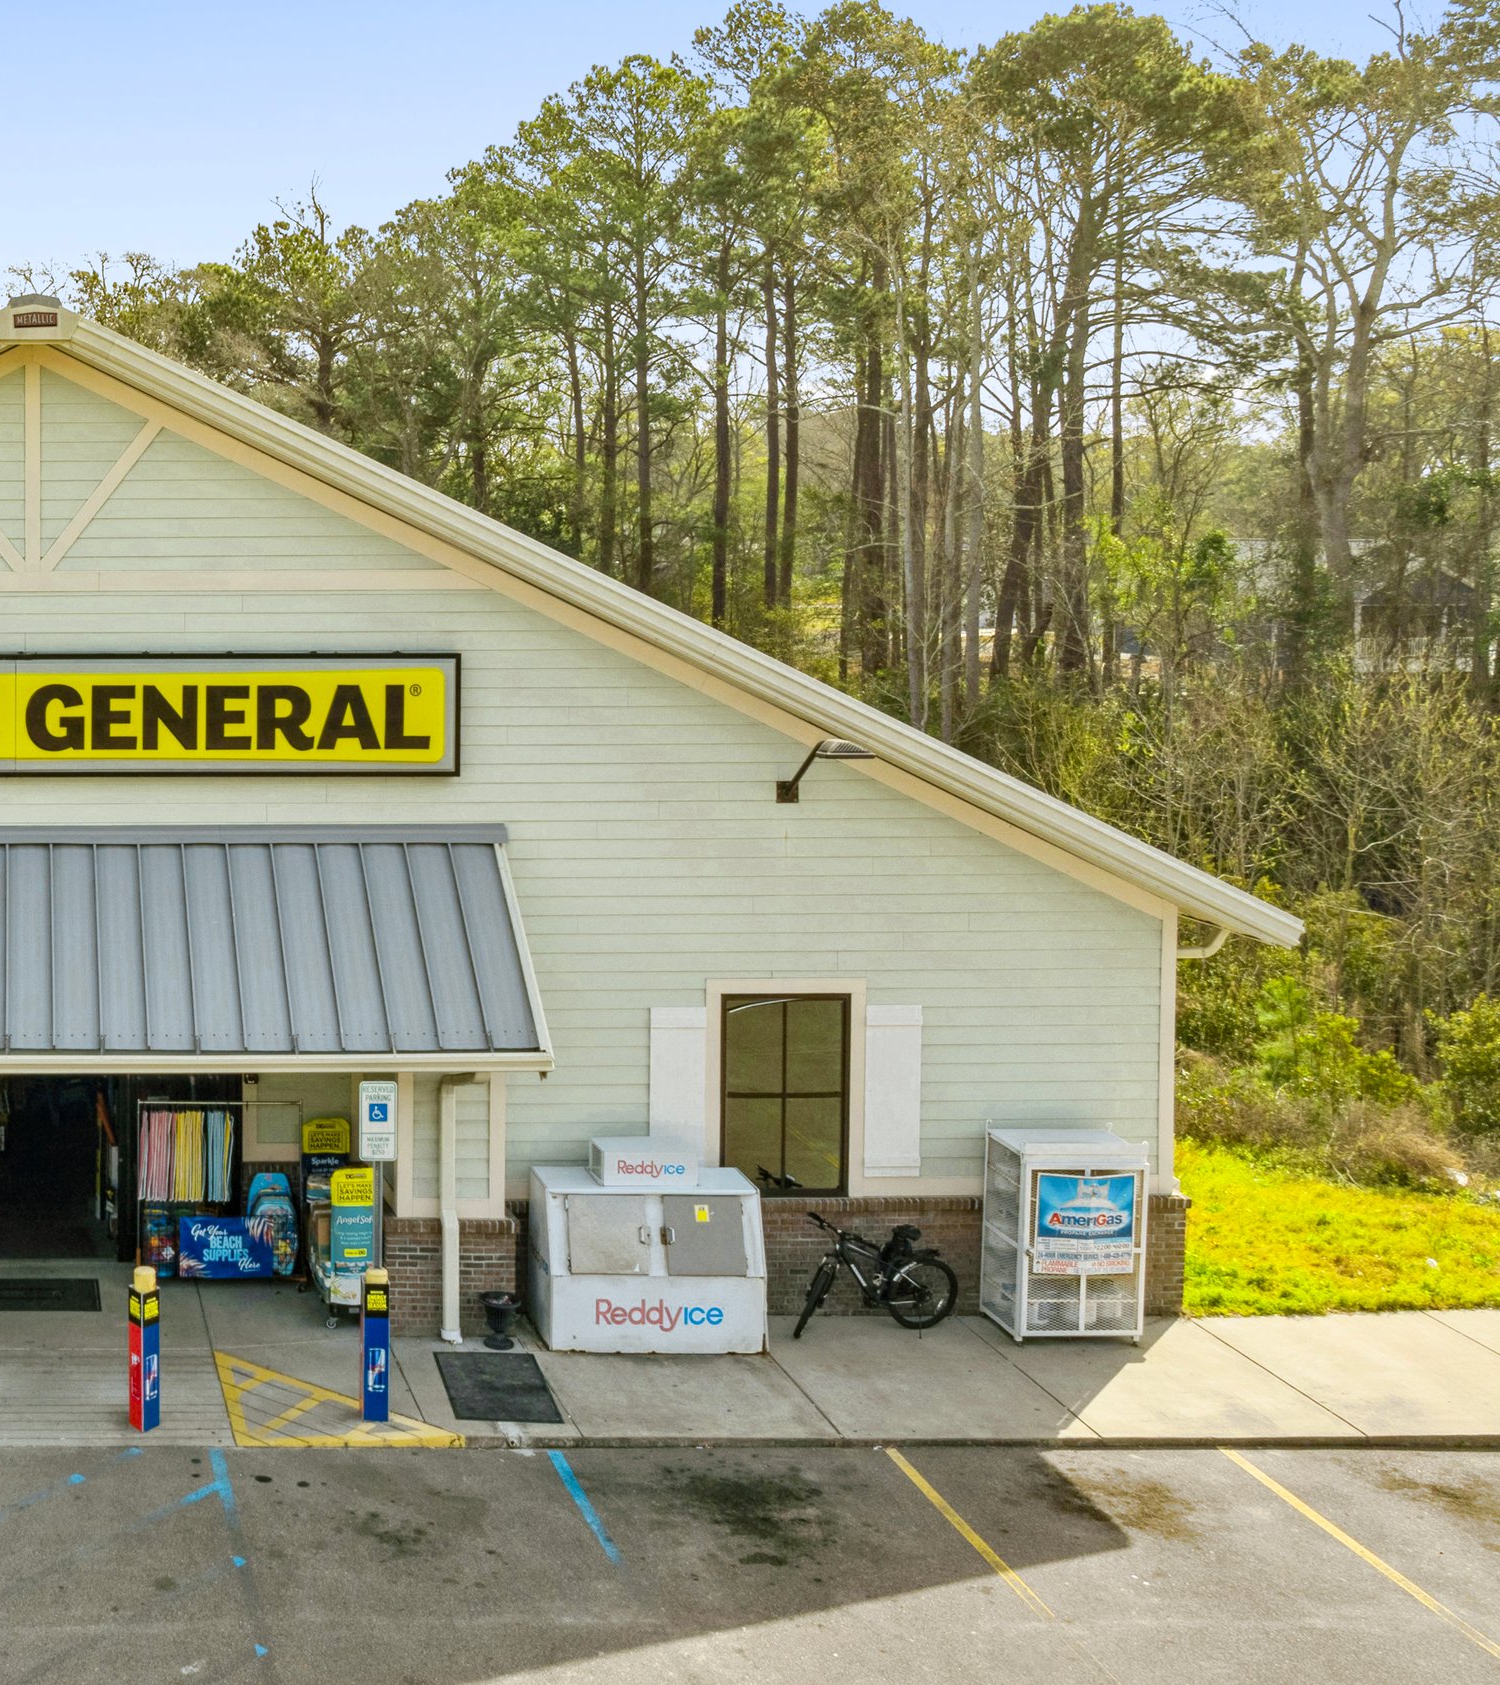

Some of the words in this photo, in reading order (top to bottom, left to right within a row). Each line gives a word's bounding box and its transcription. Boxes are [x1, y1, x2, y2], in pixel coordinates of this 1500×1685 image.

[16, 314, 55, 324] METALLIC
[311, 1156, 339, 1165] Sparkle
[1048, 1212, 1123, 1226] AmeriGas
[190, 1224, 207, 1241] Get
[207, 1224, 228, 1240] Your
[210, 1235, 242, 1249] BEACH
[203, 1249, 249, 1262] SUPPLIES
[238, 1257, 261, 1271] Here
